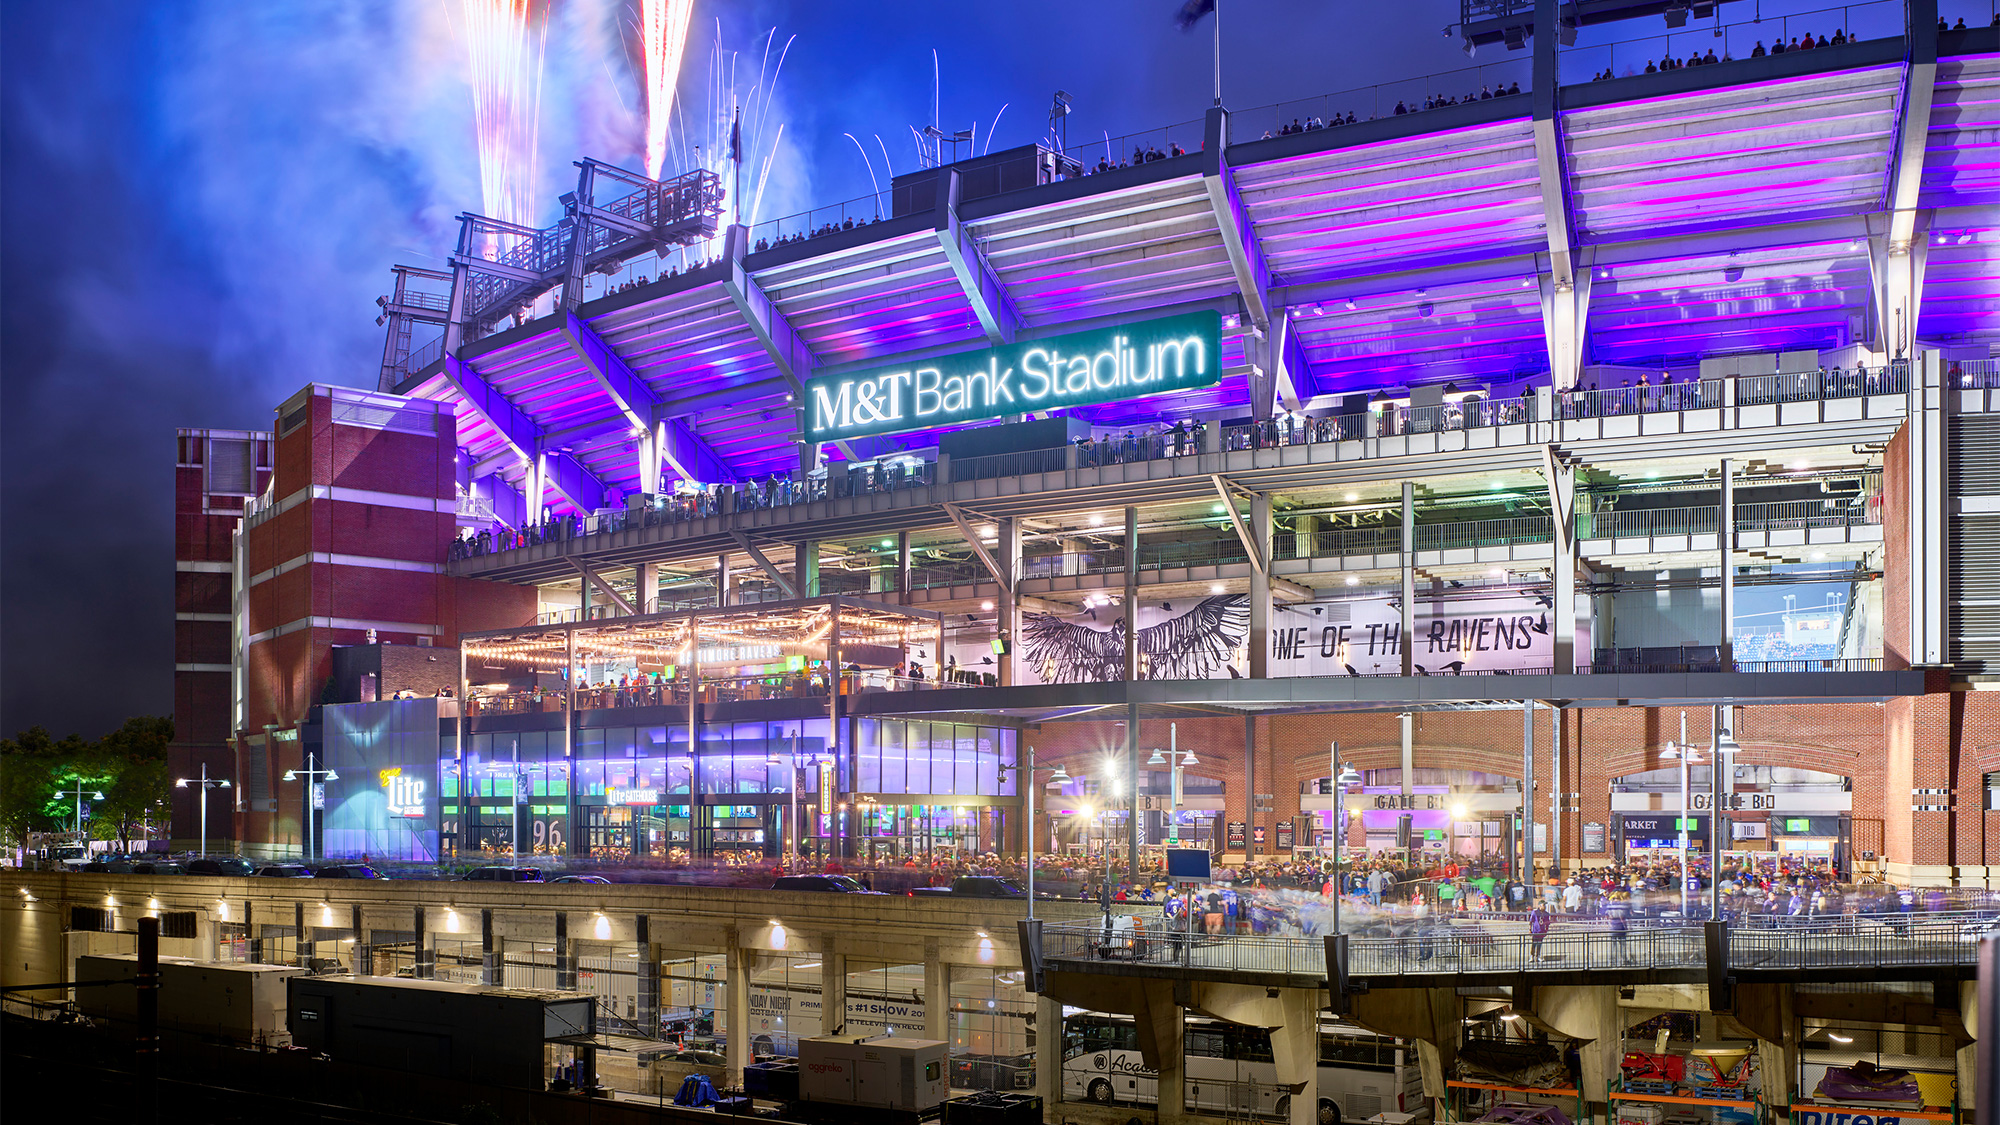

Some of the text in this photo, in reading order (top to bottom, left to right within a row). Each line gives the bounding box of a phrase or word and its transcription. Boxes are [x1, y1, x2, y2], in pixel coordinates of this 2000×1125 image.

[812, 335, 1206, 431] M&T Bank Stadium
[1320, 625, 1352, 658] OF
[1365, 623, 1401, 656] TH
[1428, 616, 1534, 653] RAVENS
[679, 644, 780, 664] BATIMORE RAVENS
[387, 775, 424, 814] Lite
[626, 790, 658, 802] GATEHOUSE
[1377, 795, 1415, 810] GATE
[1625, 820, 1658, 830] ARKET
[533, 820, 562, 847] 96
[769, 996, 792, 1010] NIGHT
[855, 1004, 868, 1013] #1
[870, 1004, 908, 1016] SHOW
[750, 1009, 785, 1018] OOTBALL
[808, 1062, 843, 1074] aggreko
